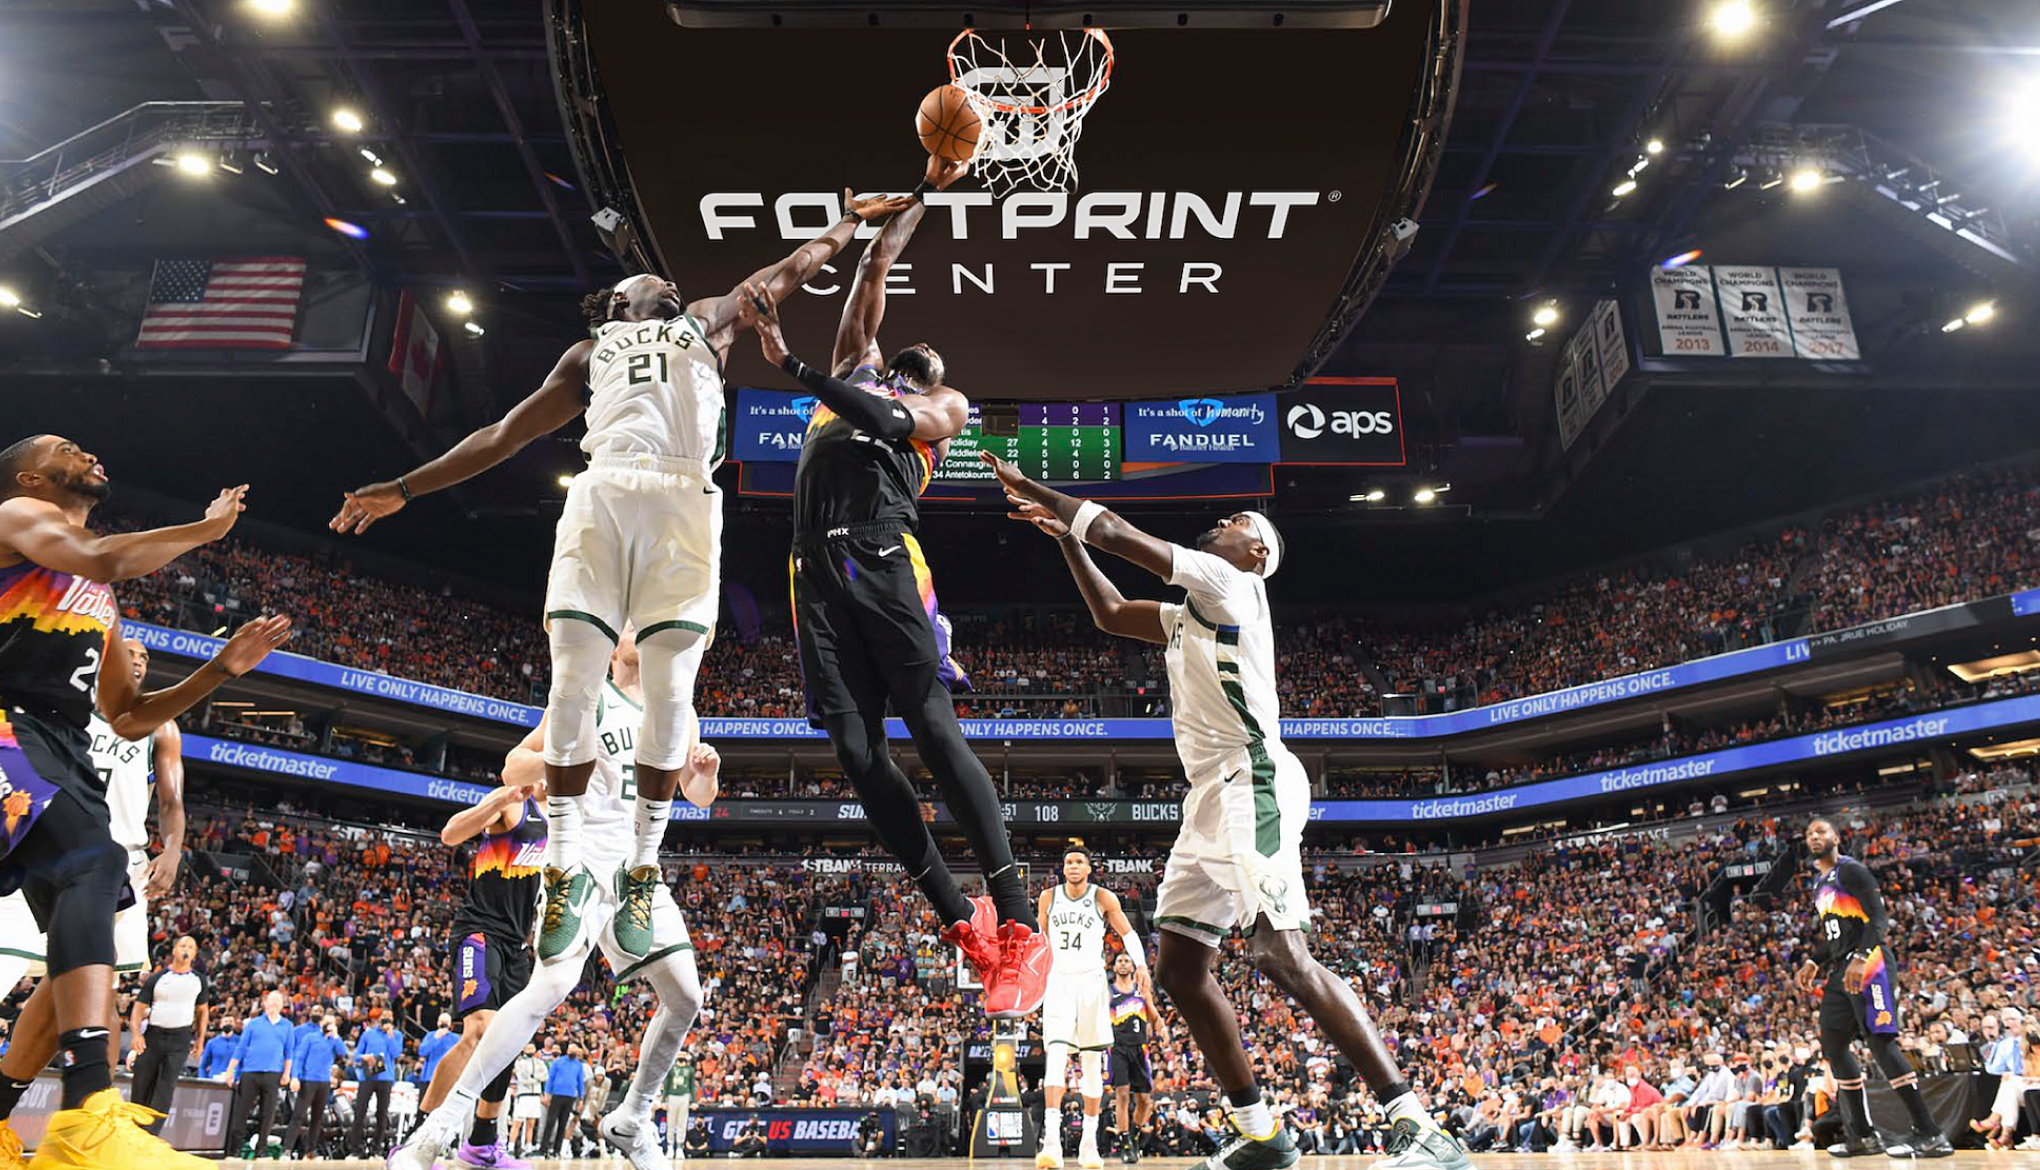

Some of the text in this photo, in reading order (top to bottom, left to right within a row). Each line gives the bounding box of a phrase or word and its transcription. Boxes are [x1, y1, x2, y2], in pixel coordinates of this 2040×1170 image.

[801, 263, 1223, 295] CENTER
[597, 325, 695, 363] BUCKS
[1675, 338, 1710, 350] 2013
[1744, 340, 1779, 352] 2014
[628, 352, 668, 386] 21
[750, 405, 767, 416] It's
[768, 408, 776, 416] a
[777, 405, 800, 416] shot
[1042, 406, 1108, 414] 1 0 1
[1138, 403, 1265, 425] It's a shot of humanity
[1042, 417, 1109, 425] 4 2 2
[1330, 410, 1393, 439] aps
[1042, 429, 1109, 437] 2 0 0
[1150, 433, 1255, 447] FANDUEL
[1007, 438, 1018, 447] 27
[1042, 439, 1048, 447] 4
[1070, 439, 1081, 447] 12
[1104, 439, 1109, 447] 3
[946, 449, 1110, 458] Middleto 22 5 4 2
[1042, 461, 1048, 469] 5
[1073, 461, 1079, 469] 0
[1104, 461, 1110, 469] 0
[932, 471, 1110, 479] 34 Antetokounmp 8 6 2
[827, 527, 850, 538] PHX
[118, 621, 170, 649] PENS
[1786, 642, 1810, 661] LIV
[341, 671, 530, 723] LIVE ONLY HAPPENS ONCE.
[1490, 671, 1675, 722] LIVE ONLY HAPPENS ONCE.
[703, 722, 771, 735] HAPPENS
[994, 722, 1061, 736] HAPPENS
[1063, 722, 1109, 736] ONCE.
[1283, 722, 1395, 736] HAPPENS ONCE.
[1813, 715, 1949, 756] ticketmaster
[92, 734, 140, 764] CKS
[210, 742, 337, 780] ticketmaster
[1600, 757, 1715, 792] ticketmaster
[714, 807, 730, 817] 24
[837, 803, 1179, 822] SU :51 108 BUCKS
[1411, 793, 1517, 820] ticketmaster
[864, 862, 906, 873] TERRA
[1101, 859, 1154, 873] TBANK
[1052, 911, 1095, 929] BUCKS
[1060, 931, 1082, 951] 34
[463, 946, 474, 978] SUNS
[1132, 1019, 1141, 1033] 3
[768, 1120, 793, 1140] US
[793, 1120, 861, 1141] BASEBA
